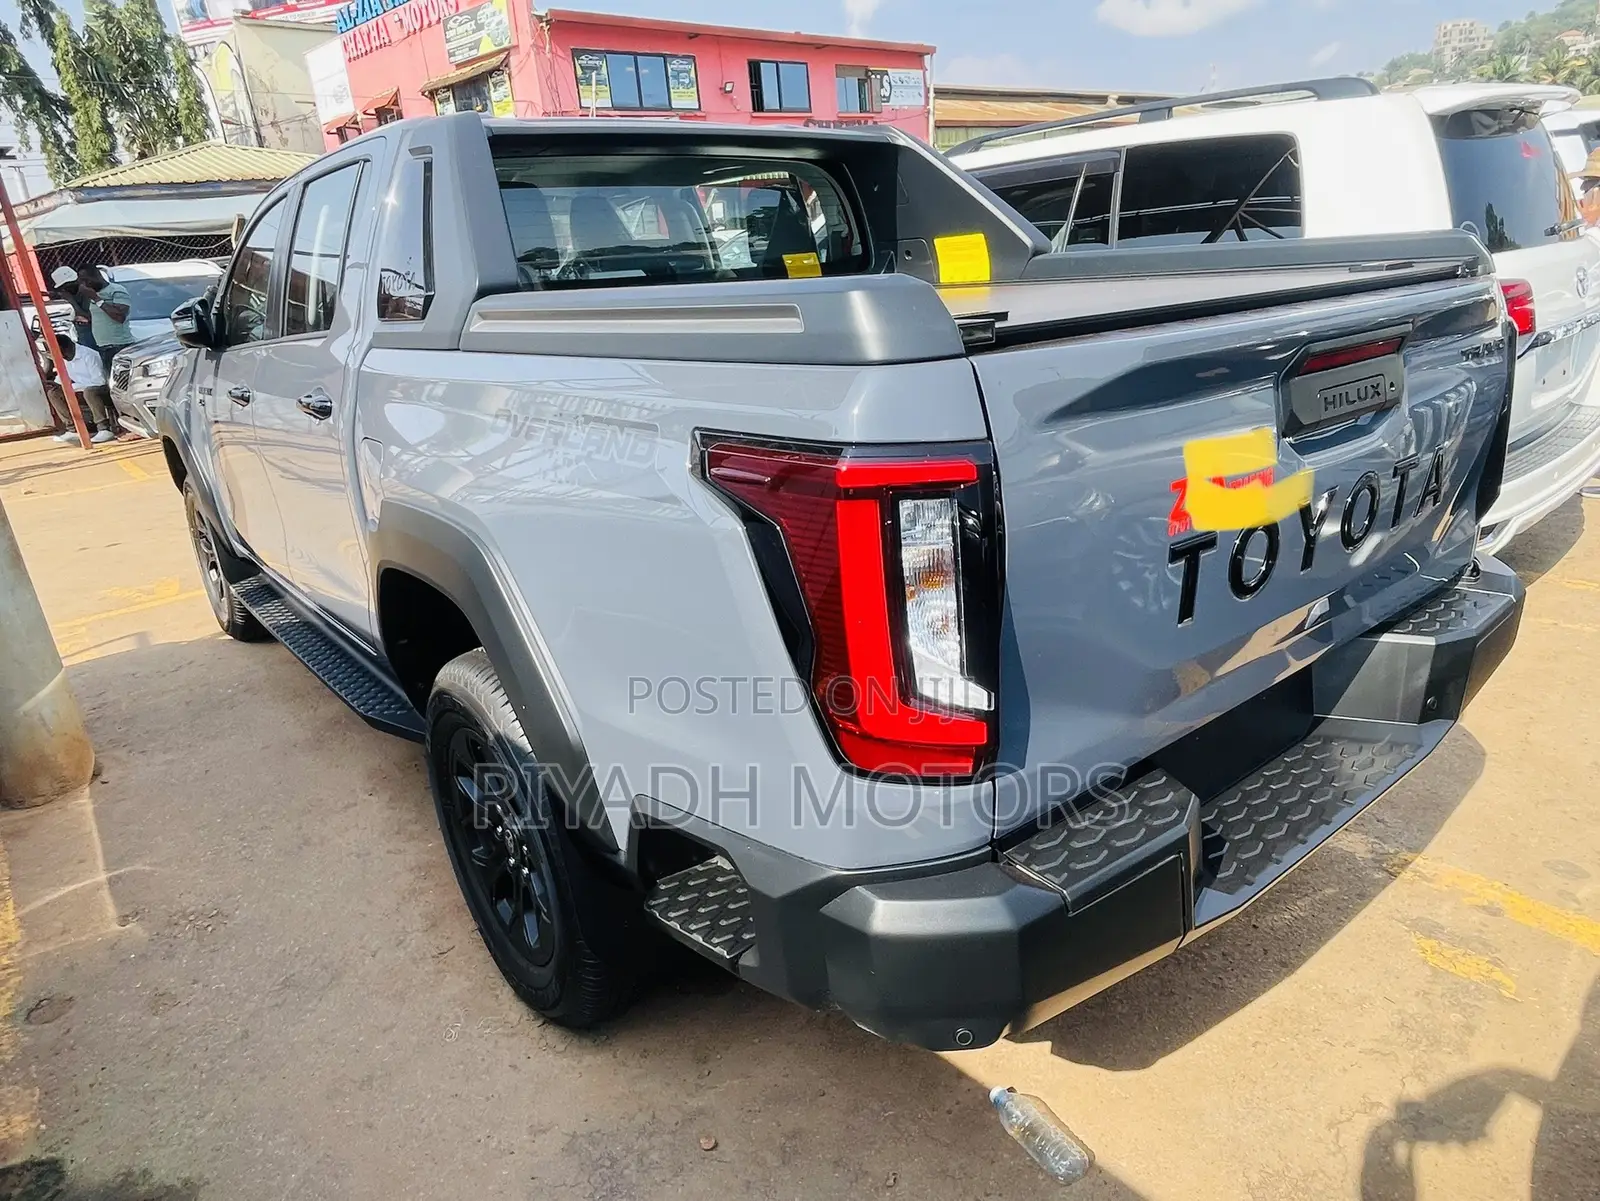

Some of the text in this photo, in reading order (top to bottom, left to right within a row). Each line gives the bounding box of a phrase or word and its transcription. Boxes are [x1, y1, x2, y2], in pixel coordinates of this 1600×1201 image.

[1323, 382, 1381, 412] HILUX
[491, 409, 658, 469] OVERLAND
[1167, 443, 1444, 628] TOYOTA
